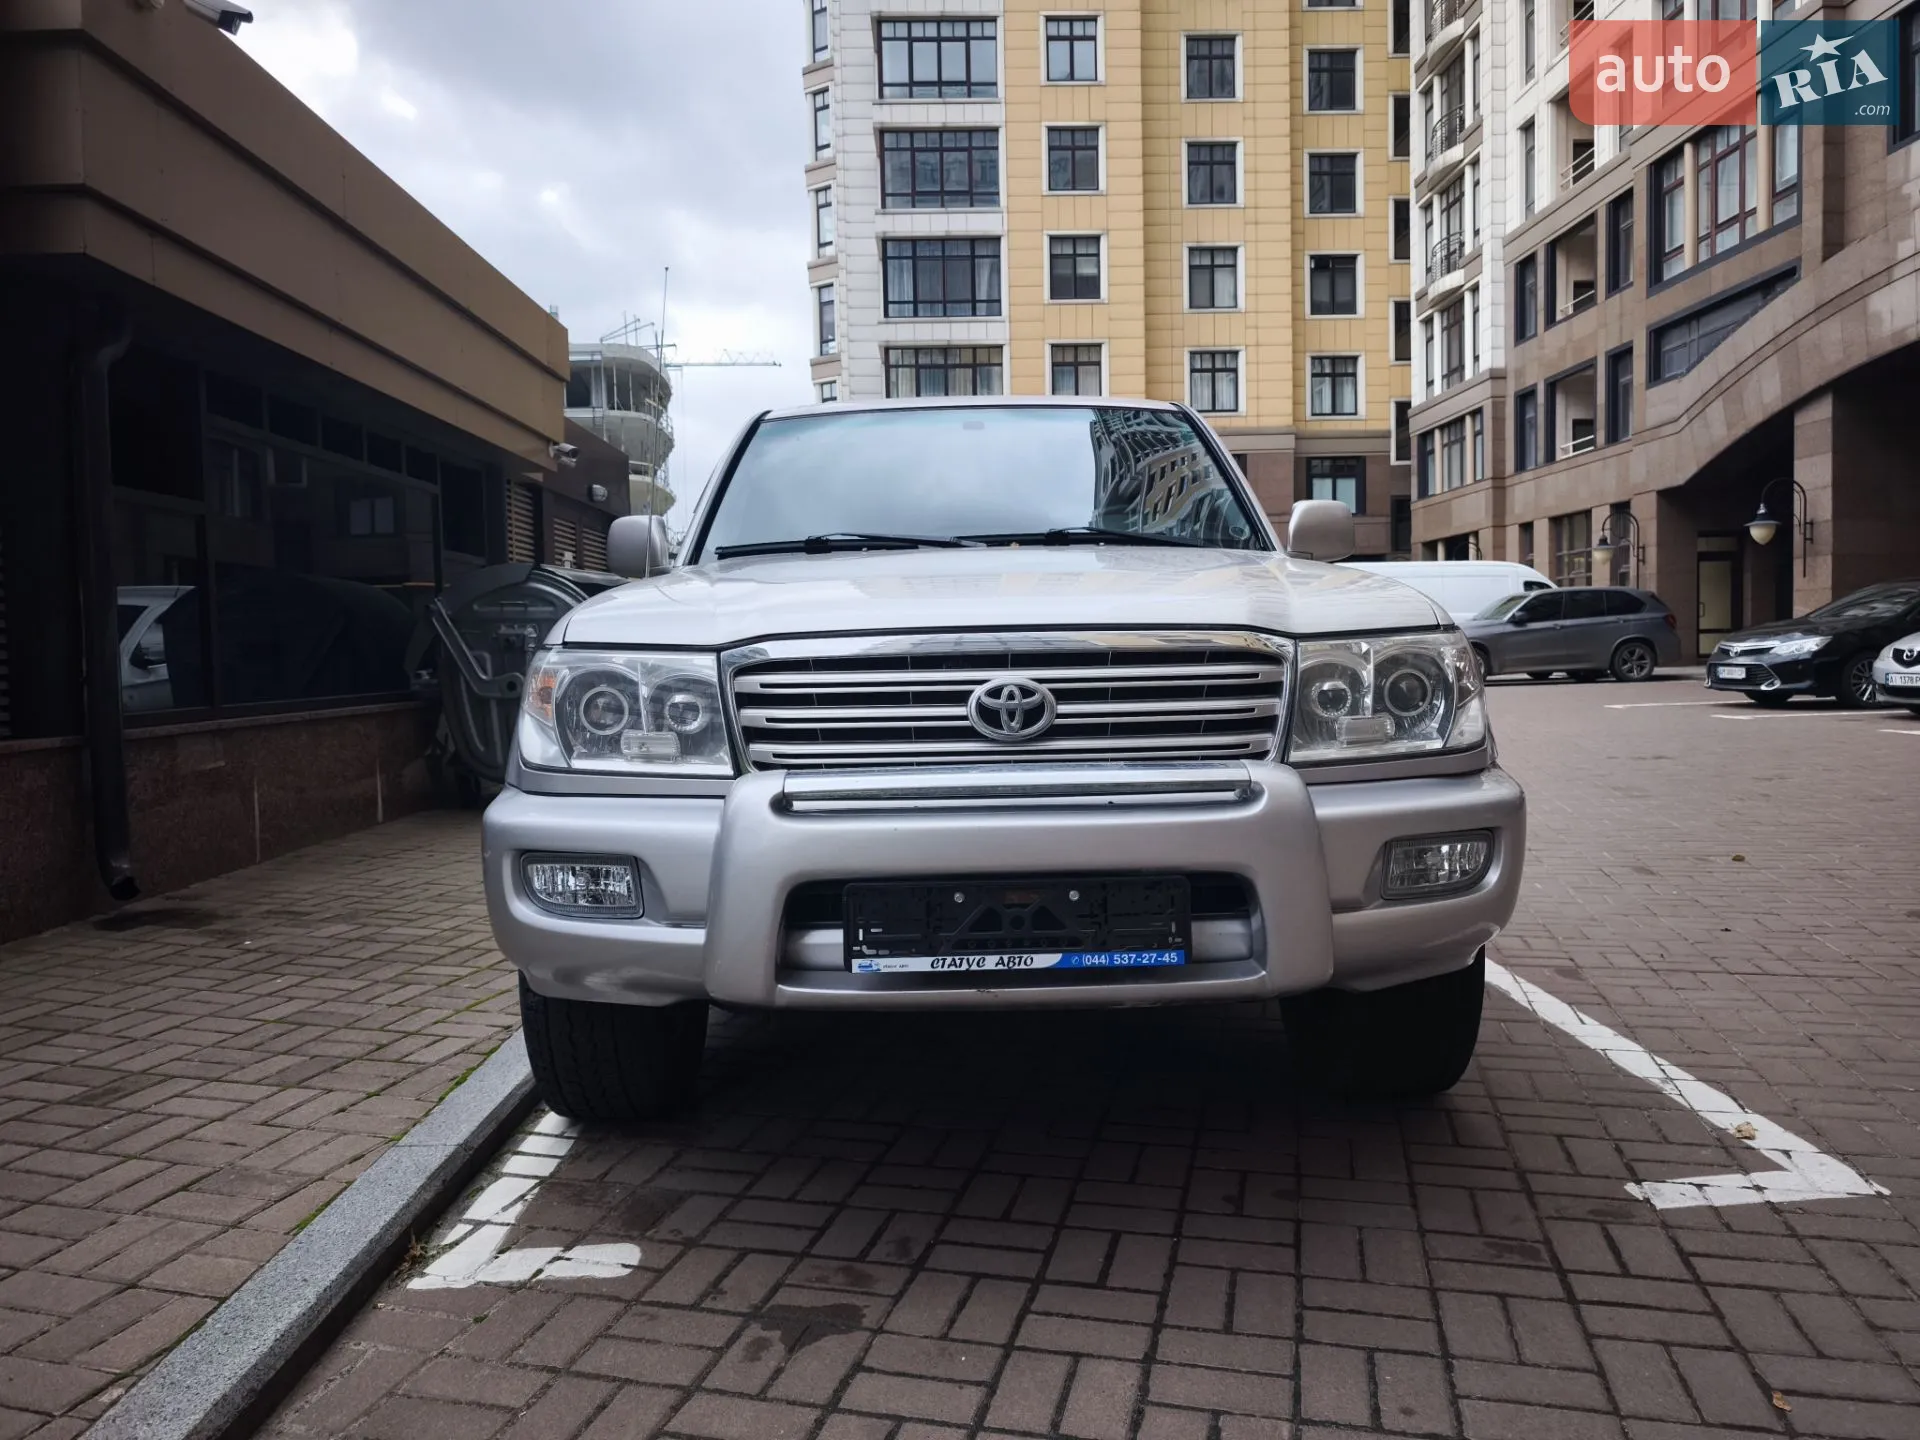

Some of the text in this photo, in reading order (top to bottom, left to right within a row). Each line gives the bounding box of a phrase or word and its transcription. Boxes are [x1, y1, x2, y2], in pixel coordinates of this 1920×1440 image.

[930, 952, 1178, 970] СТАТУС АВТО (044) 537-27-45
